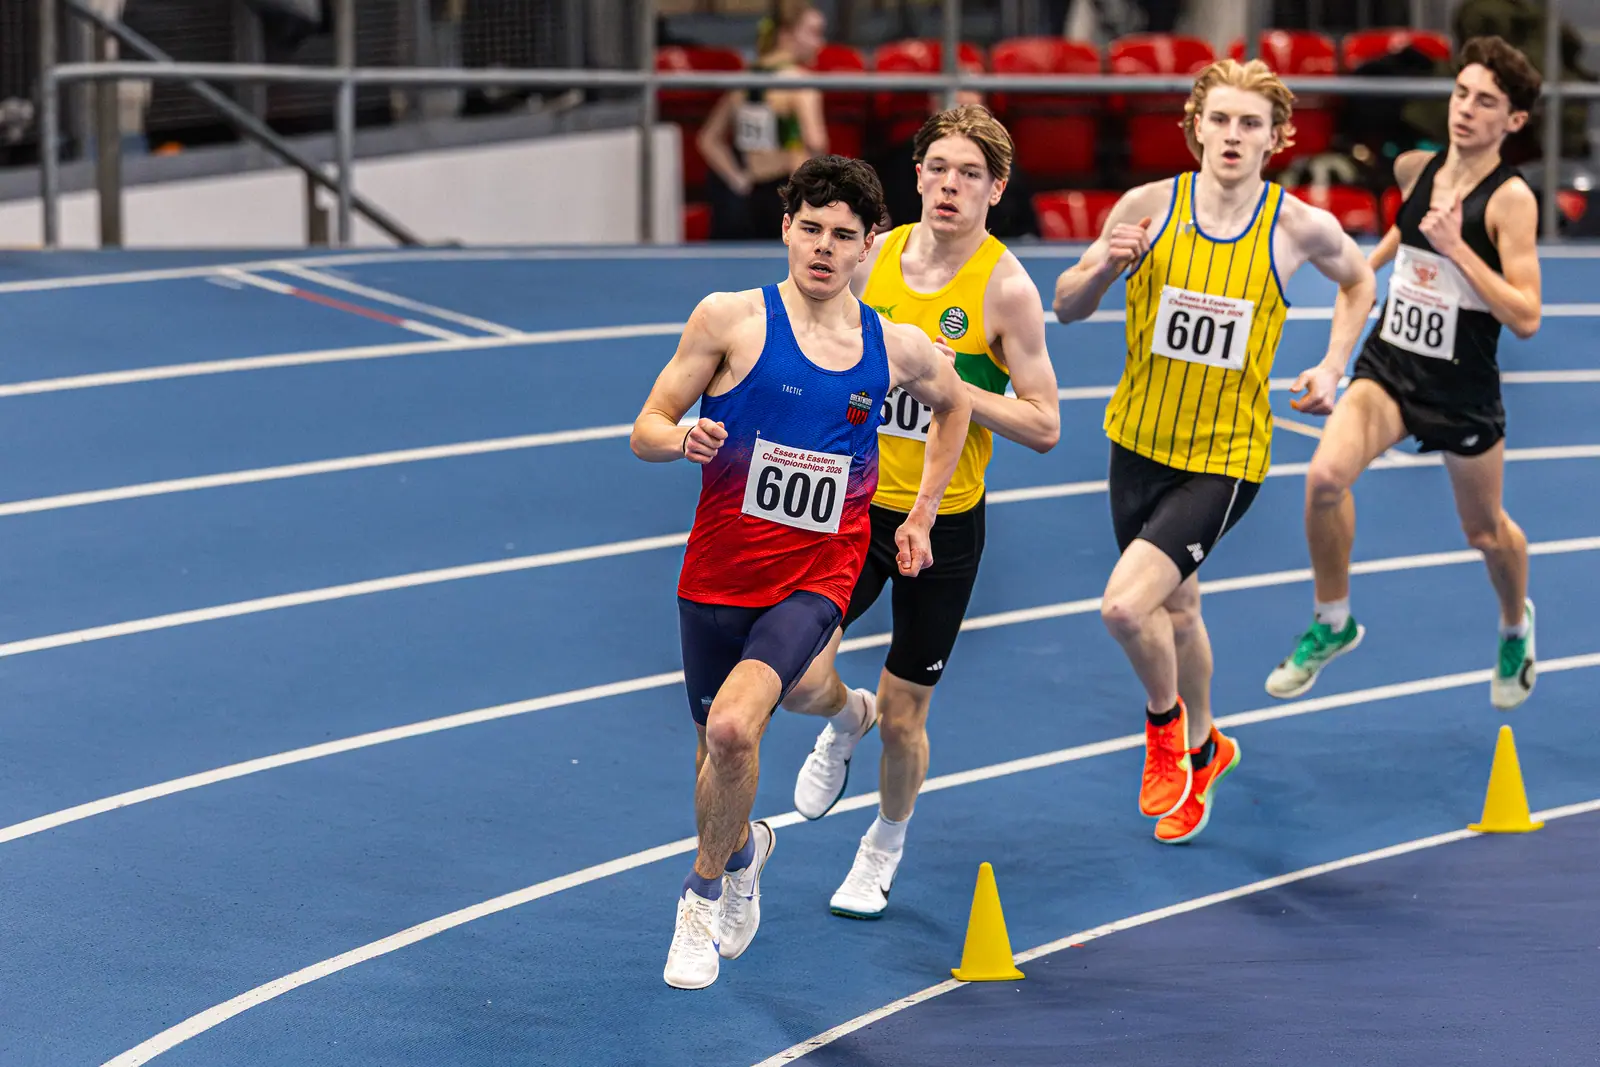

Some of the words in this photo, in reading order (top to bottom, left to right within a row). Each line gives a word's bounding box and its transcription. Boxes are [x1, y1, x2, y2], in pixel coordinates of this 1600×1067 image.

[1166, 310, 1236, 360] 601
[1390, 298, 1444, 348] 598
[782, 384, 803, 396] TACTIC
[762, 452, 824, 473] Championships
[825, 465, 843, 474] 2026
[773, 447, 798, 459] Essex
[798, 453, 805, 461] &
[806, 454, 836, 465] Eastern
[756, 465, 836, 524] 600
